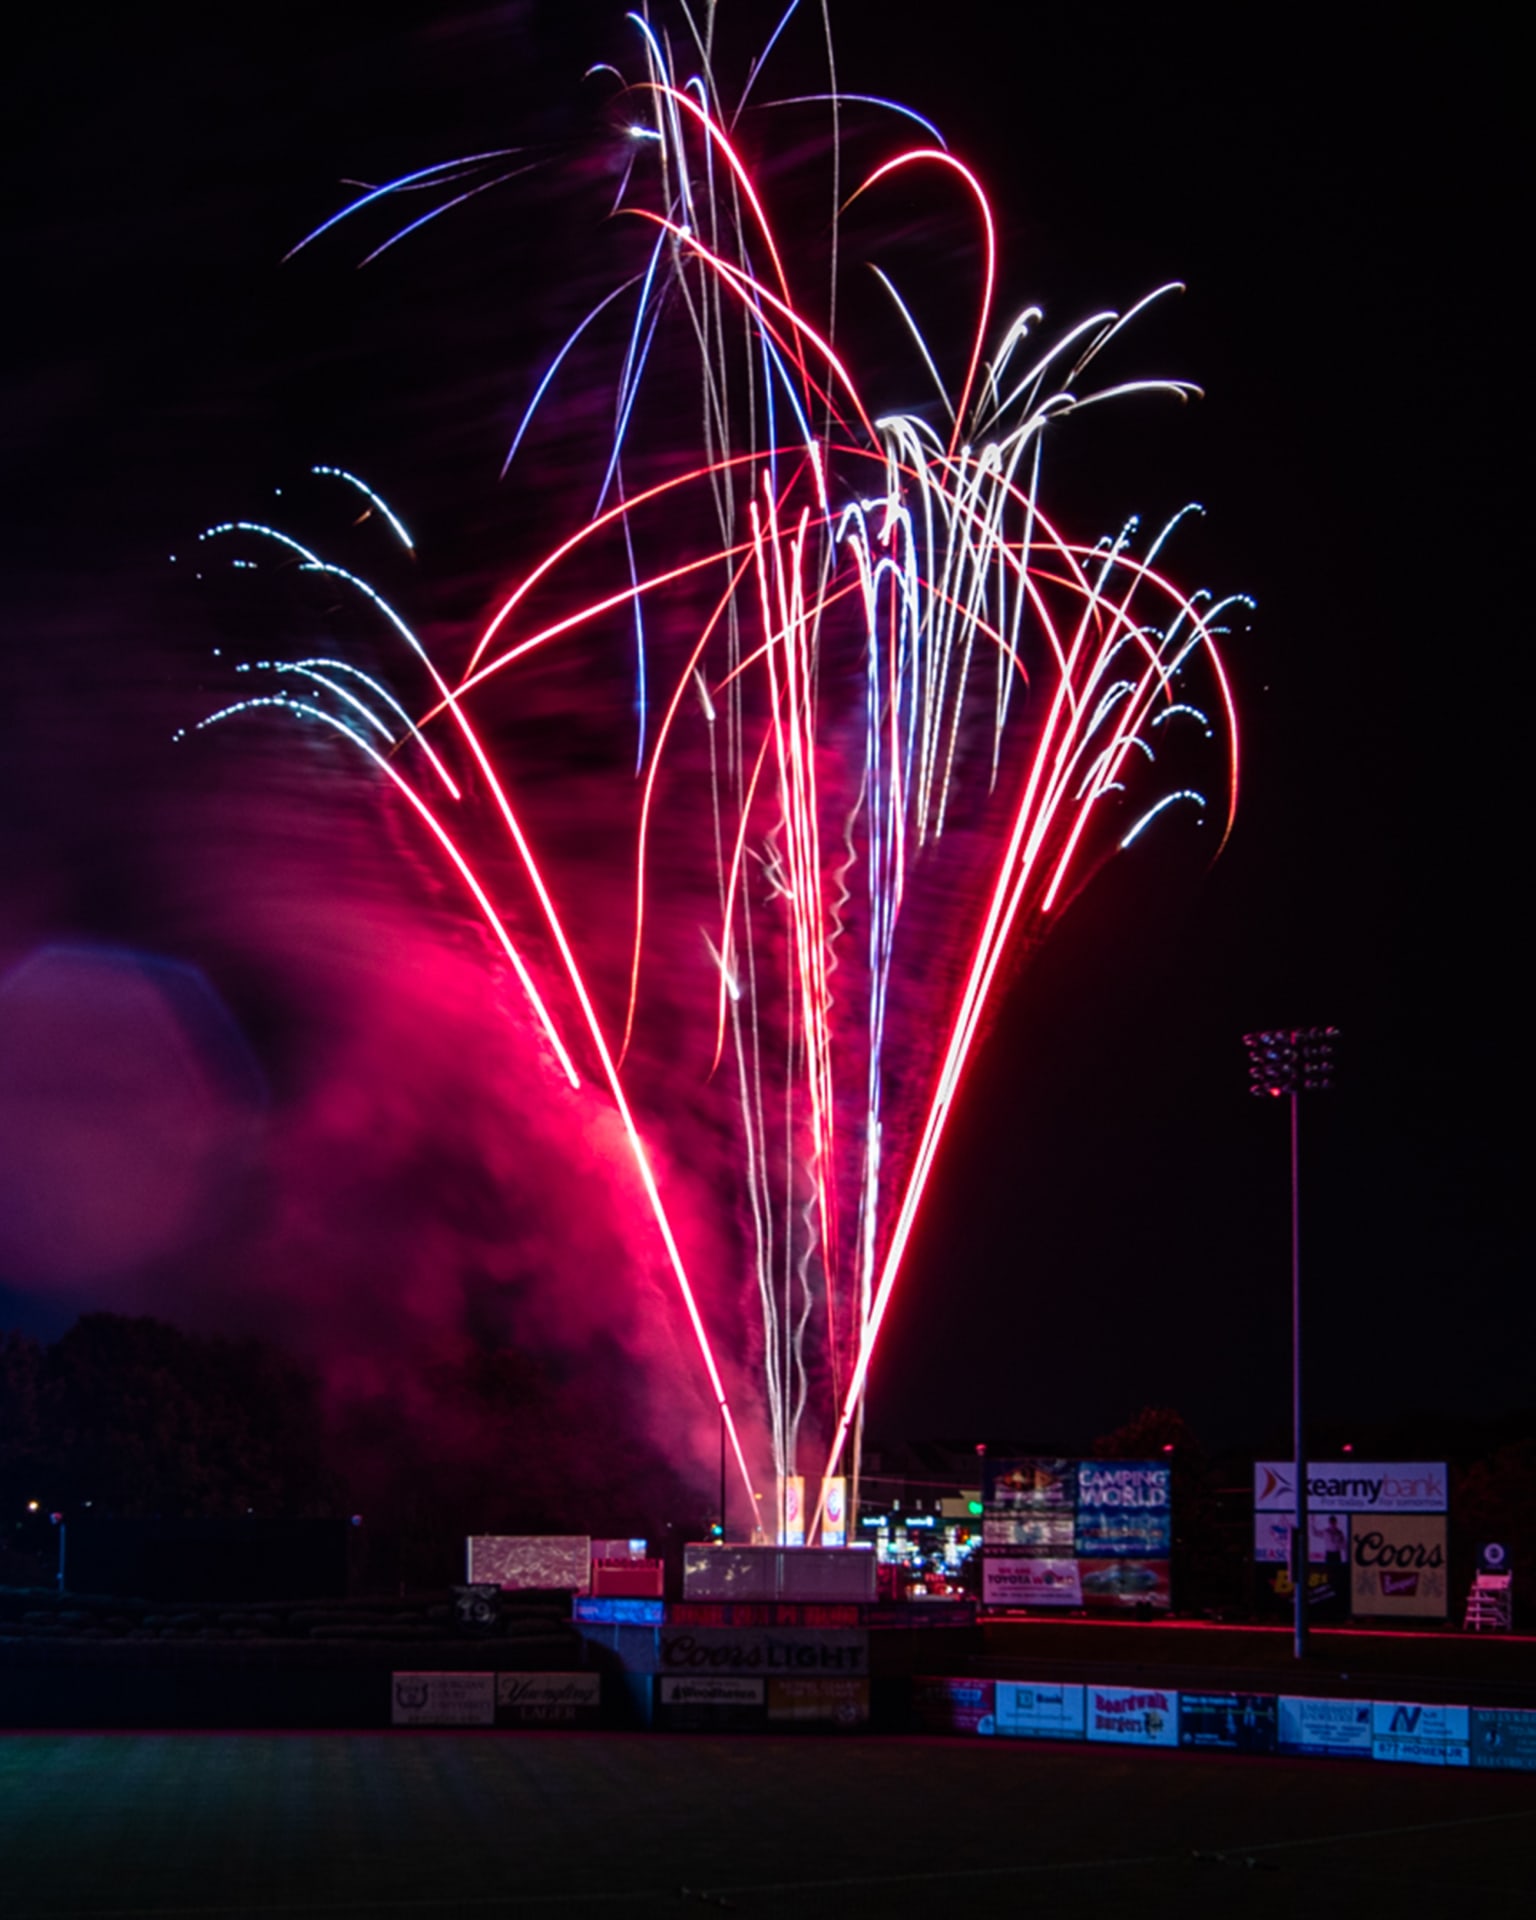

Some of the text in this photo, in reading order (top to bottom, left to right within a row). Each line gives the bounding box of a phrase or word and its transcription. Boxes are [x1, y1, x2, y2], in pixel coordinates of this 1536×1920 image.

[1077, 1469, 1166, 1487] CAMPING
[1079, 1487, 1166, 1507] WORLD
[1352, 1531, 1443, 1568] Coors
[987, 1575, 1031, 1585] TOYOTA
[459, 1601, 490, 1621] 19
[662, 1635, 865, 1669] Coors LIGHT
[1095, 1692, 1169, 1713] Boardwalk
[519, 1707, 577, 1720] LAGER
[1095, 1714, 1143, 1733] Burgers
